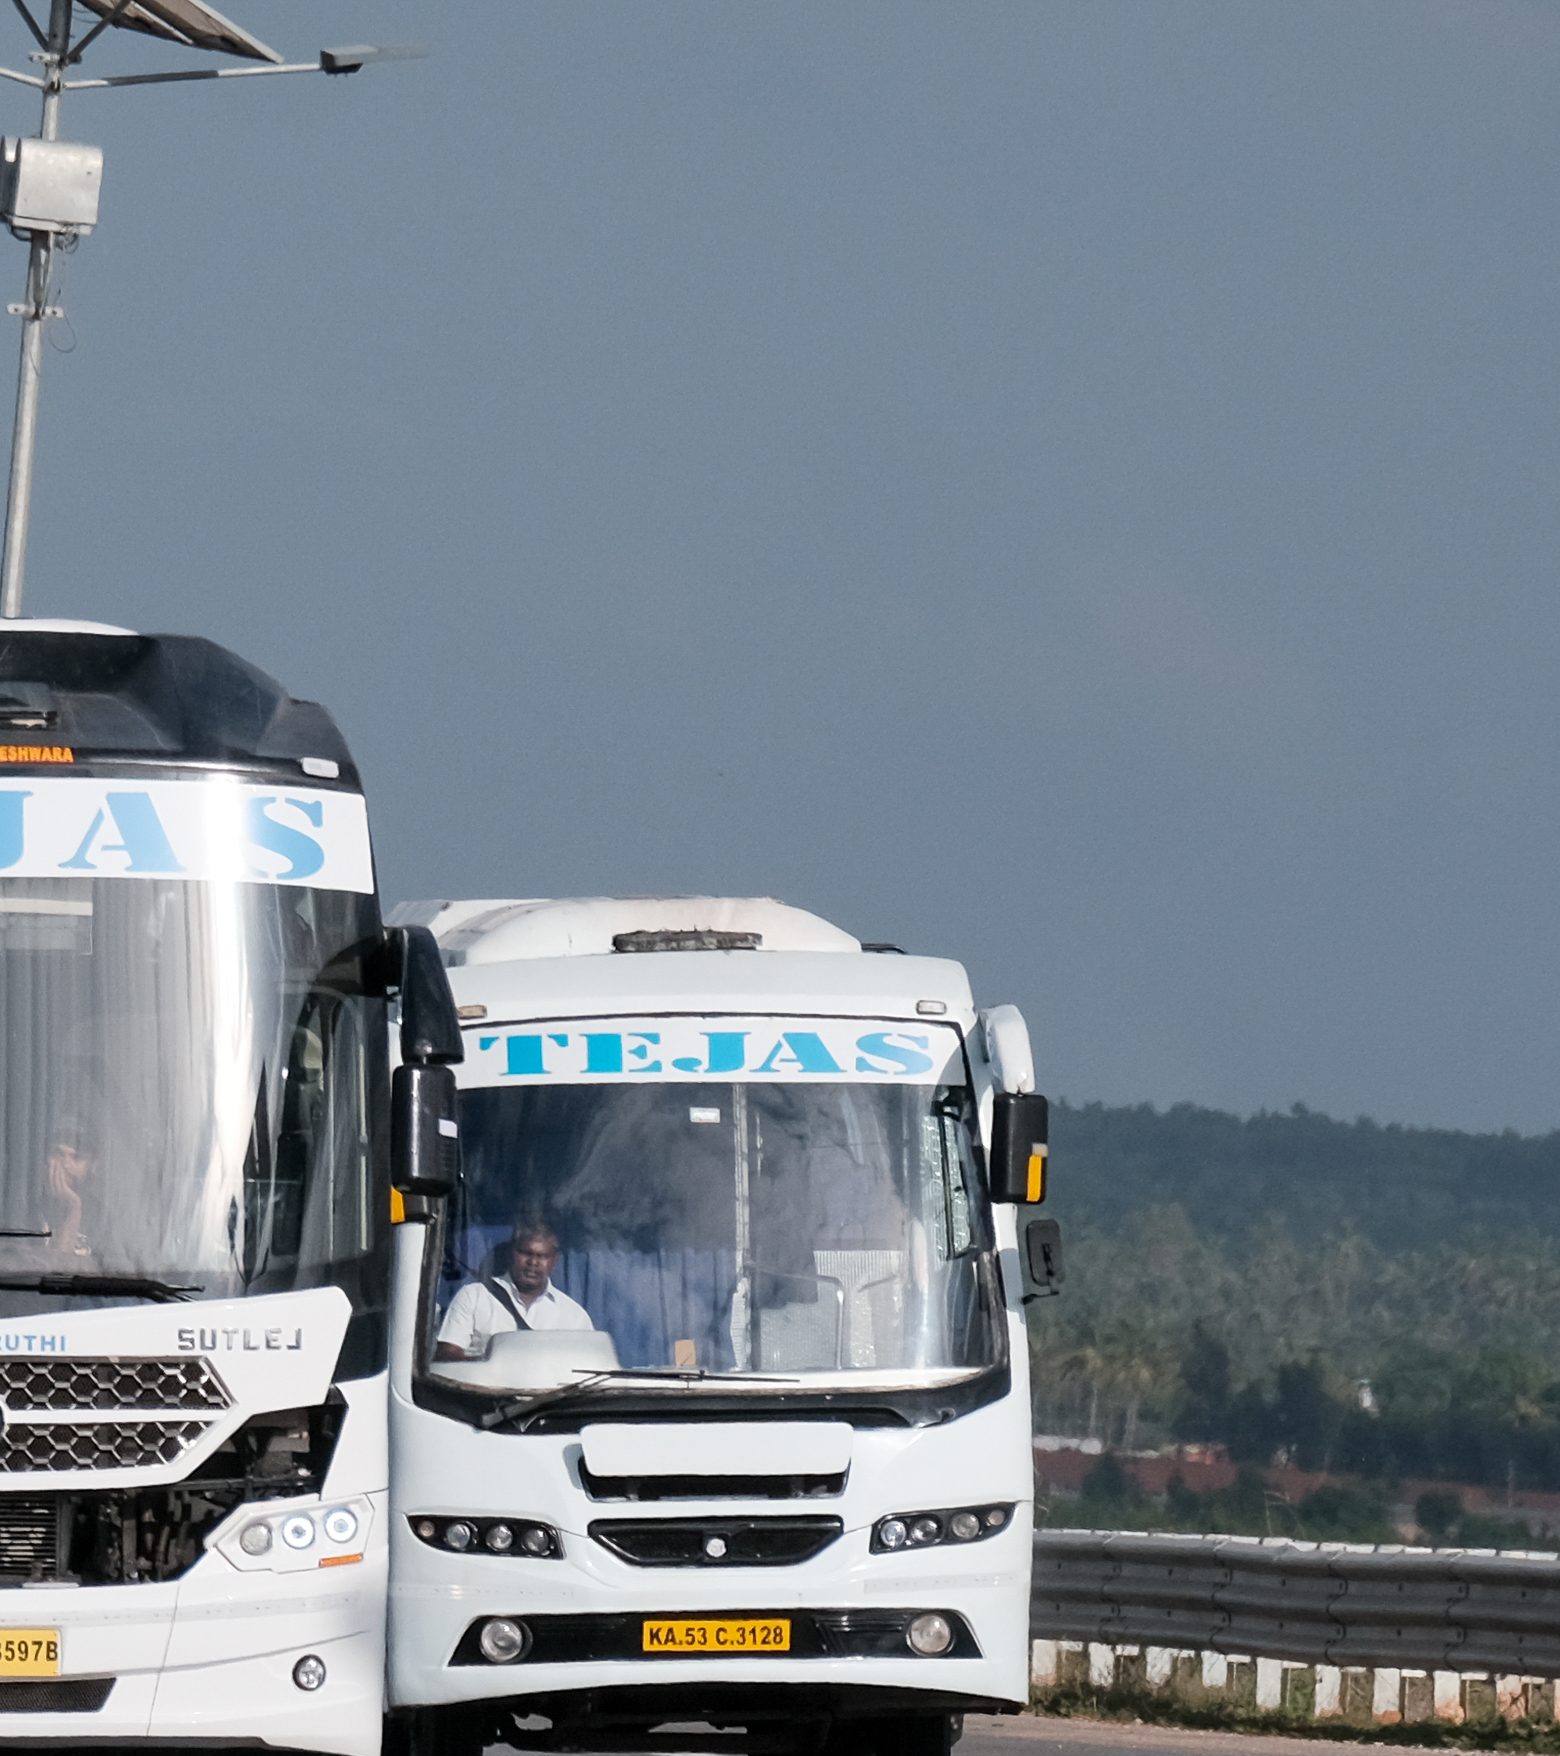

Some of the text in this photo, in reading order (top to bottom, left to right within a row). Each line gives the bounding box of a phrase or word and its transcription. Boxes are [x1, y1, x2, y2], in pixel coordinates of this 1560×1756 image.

[480, 1031, 934, 1075] TEJAS
[178, 1327, 302, 1351] SUTLEJ
[649, 1626, 783, 1646] KA.53 C.3128
